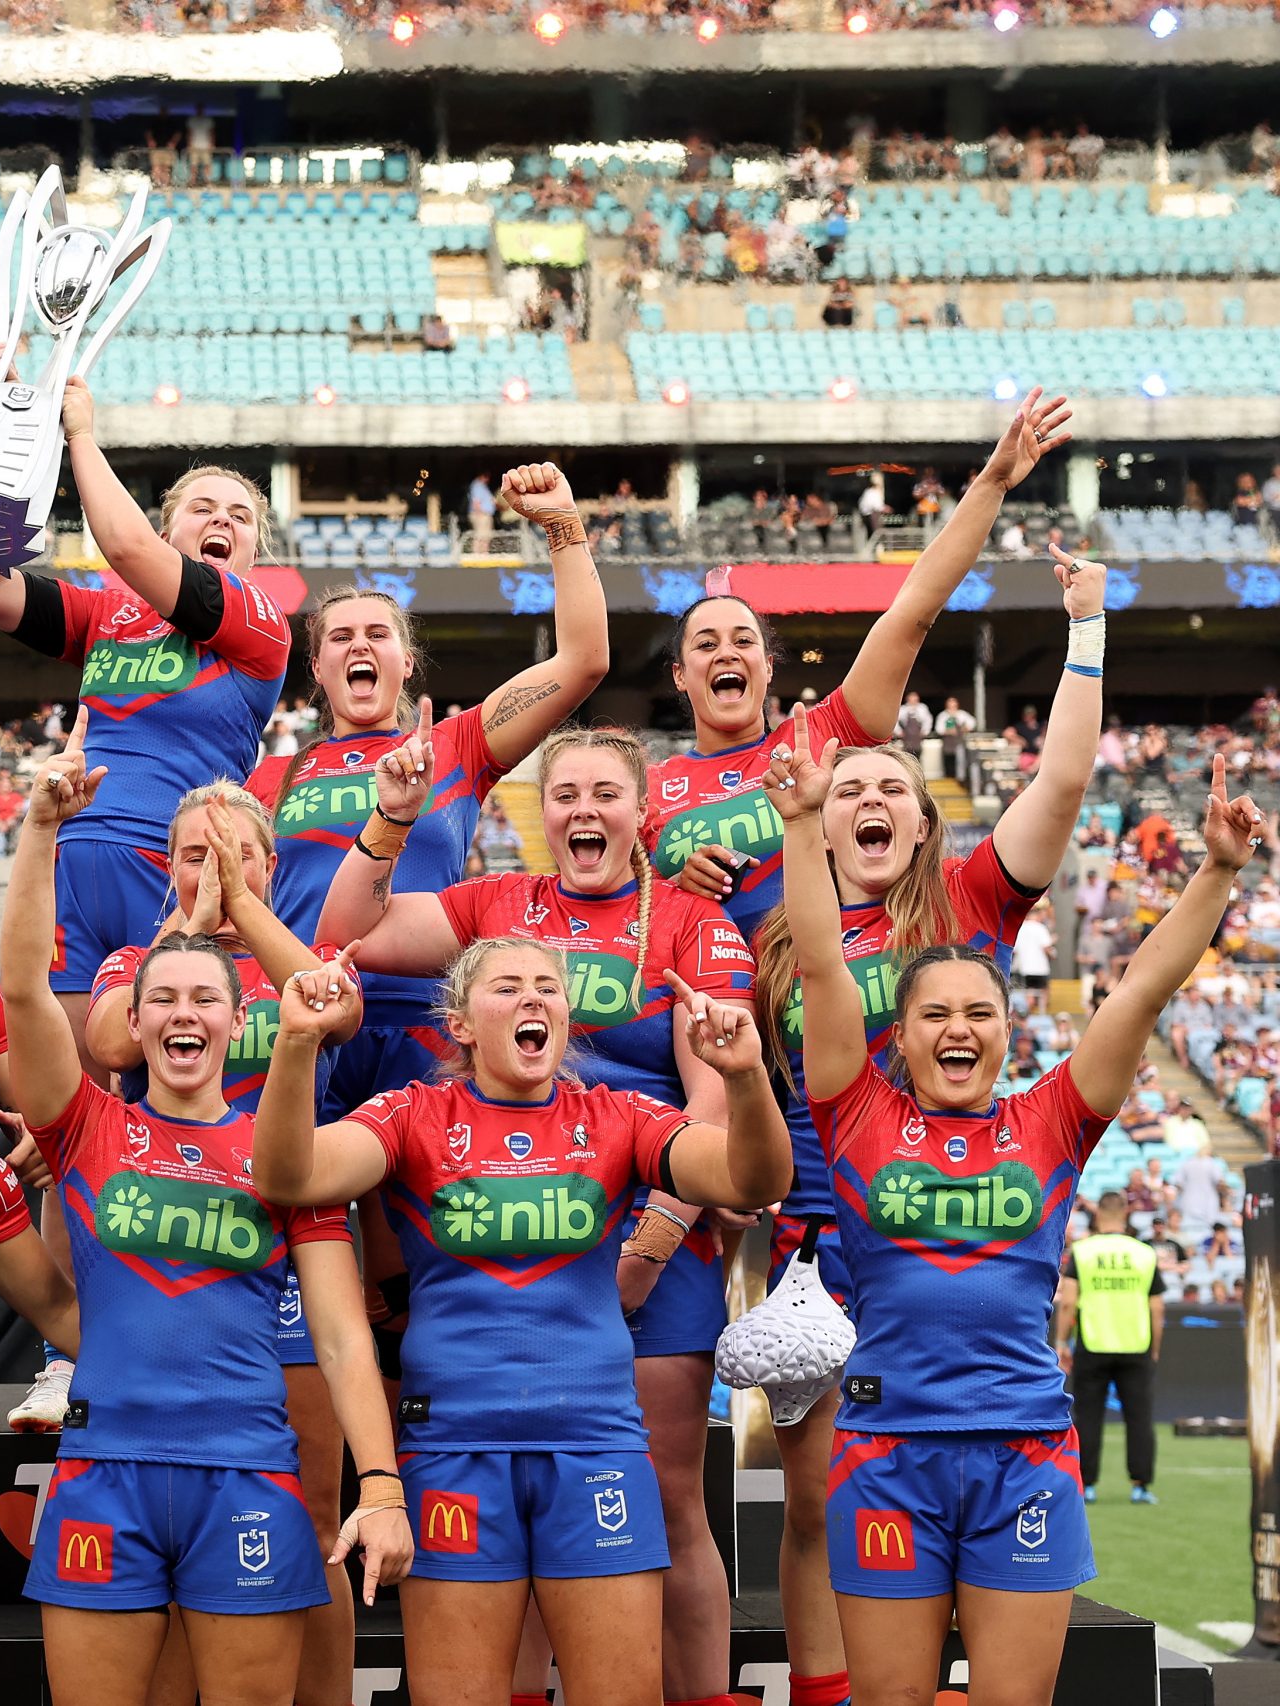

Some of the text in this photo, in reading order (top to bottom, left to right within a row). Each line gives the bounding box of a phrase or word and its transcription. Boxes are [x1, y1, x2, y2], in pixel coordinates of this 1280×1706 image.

[109, 642, 184, 684] nib
[564, 1150, 596, 1160] KNIGHTS
[500, 1187, 595, 1241] nib
[934, 1176, 1033, 1226] nib
[156, 1198, 260, 1259] nib
[586, 1473, 616, 1483] CLASSIC
[232, 1513, 262, 1522] CLASSIC
[596, 1538, 633, 1548] PREMIERSHIP
